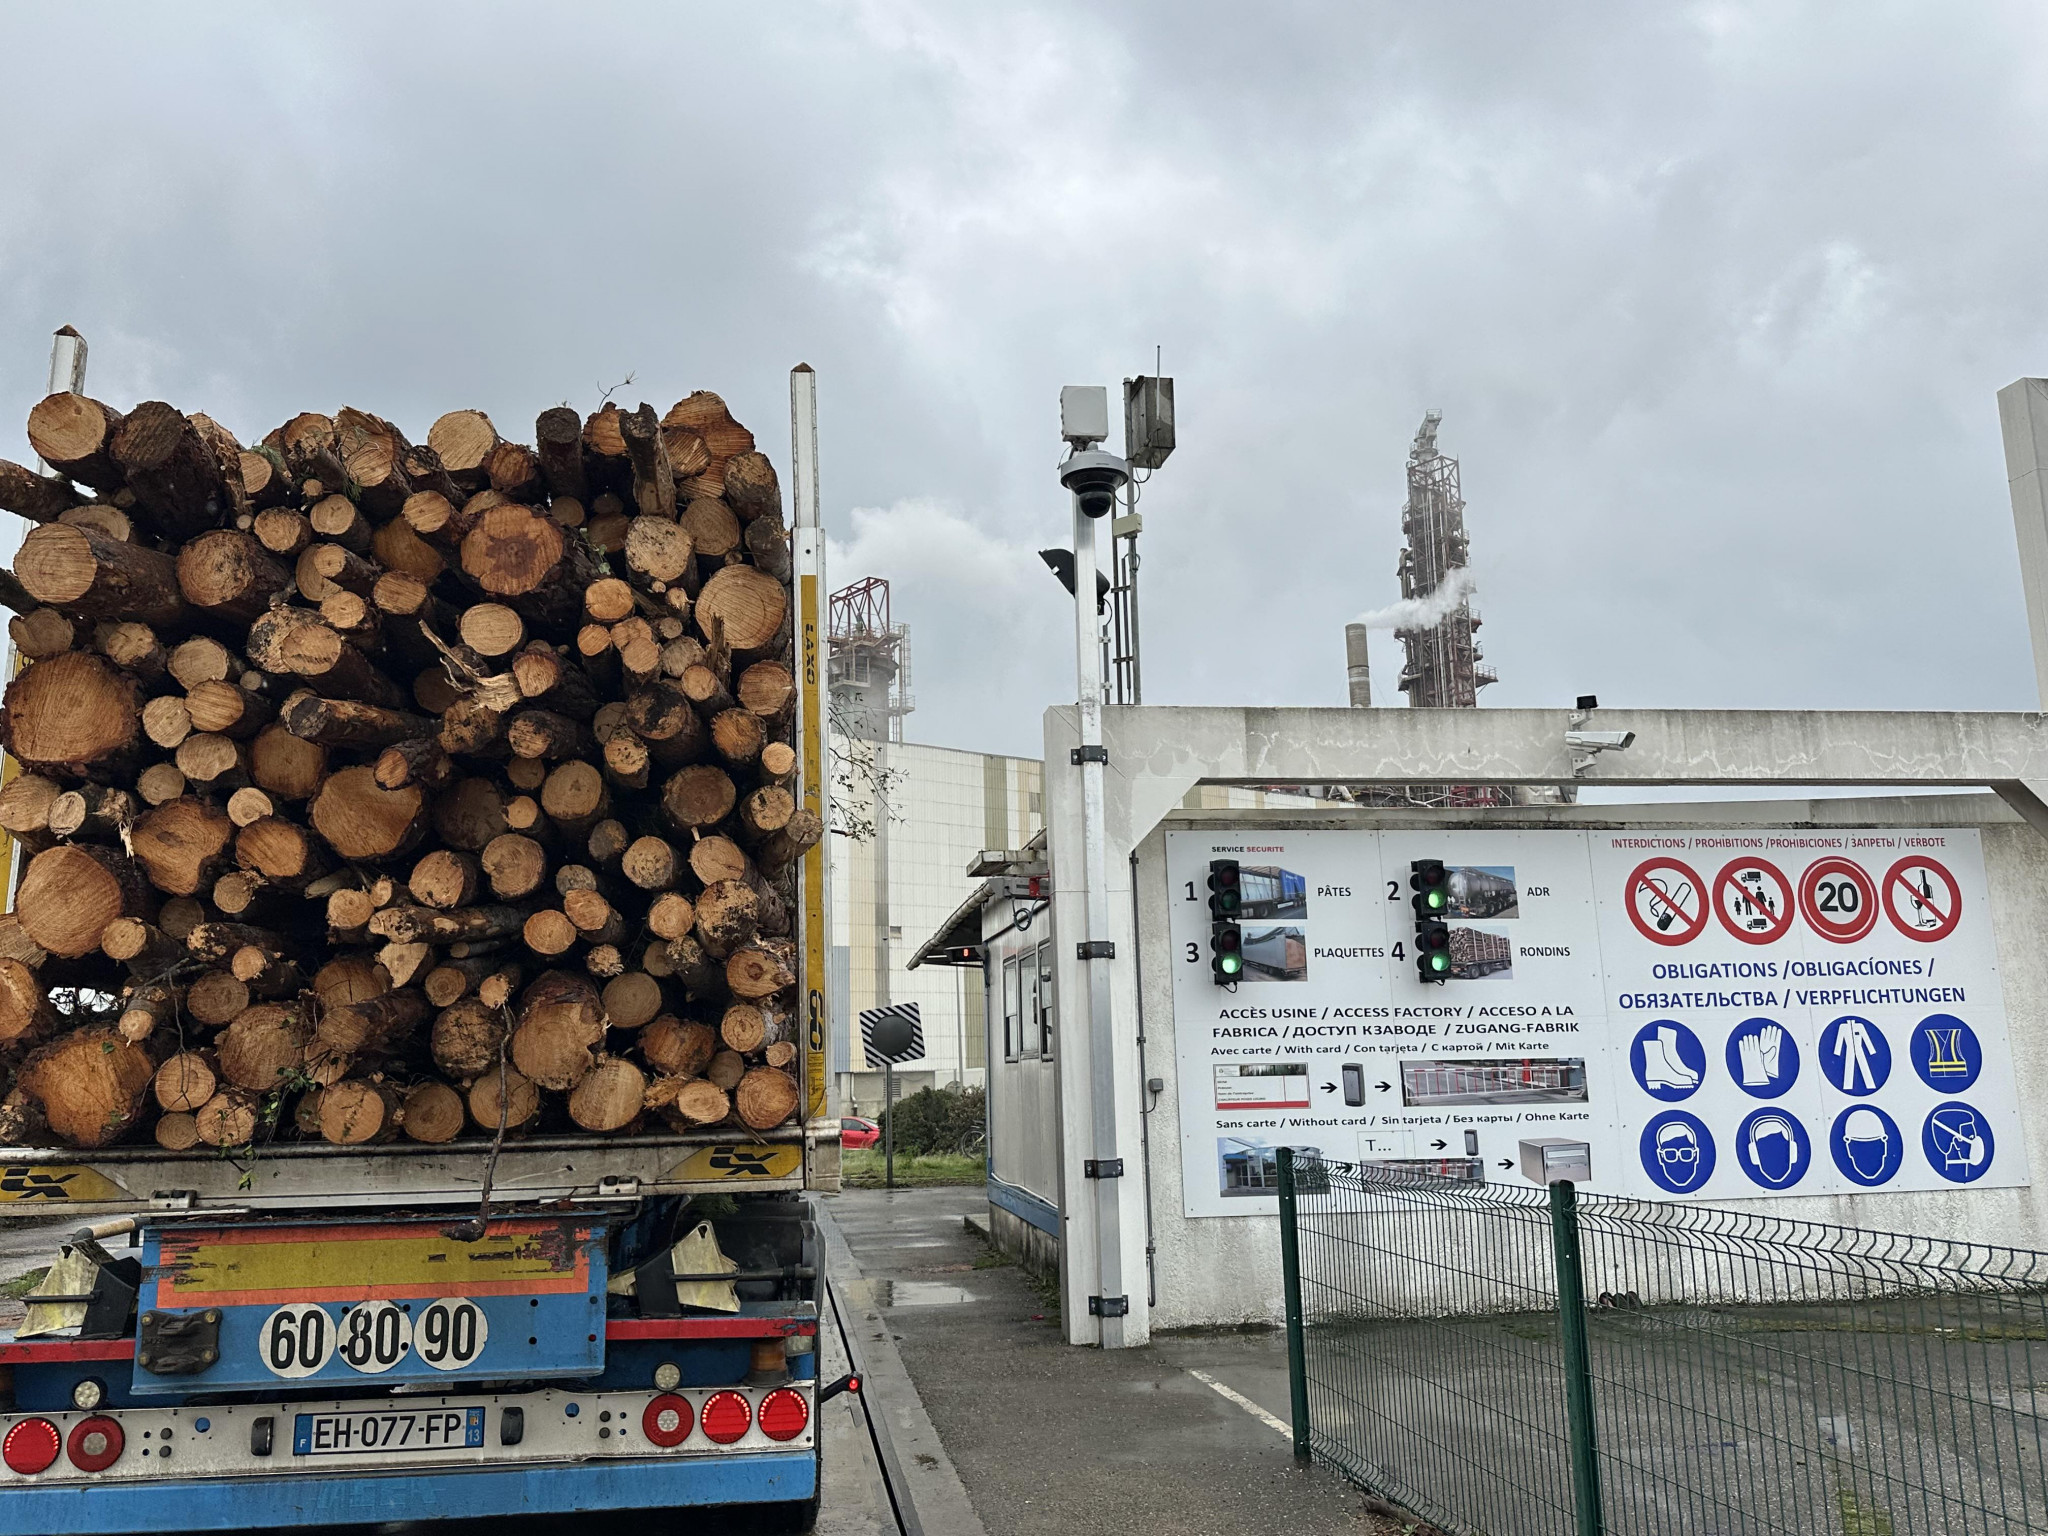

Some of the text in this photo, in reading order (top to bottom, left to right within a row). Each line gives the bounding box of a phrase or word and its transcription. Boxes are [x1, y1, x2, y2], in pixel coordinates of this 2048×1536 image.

[806, 623, 815, 685] LAXO
[1612, 839, 1685, 848] INTERDICTIONS
[1696, 838, 1763, 847] PROHIBITIONS
[1904, 838, 1945, 847] VERBOTE
[1185, 882, 1197, 901] 1
[1318, 885, 1351, 896] PÂTES
[1387, 881, 1400, 900] 2
[1528, 887, 1549, 896] ADR
[1818, 882, 1858, 912] 20
[1187, 943, 1199, 963] 3
[1315, 948, 1384, 958] PLAQUETTES
[1392, 942, 1405, 961] 4
[1520, 947, 1570, 956] RONDINS
[1653, 963, 1777, 979] OBLIGATIONS
[1796, 988, 1965, 1005] VERPFLICHTUNGEN
[1220, 1007, 1266, 1018] ACCÈS
[1272, 1009, 1316, 1018] USINE
[1334, 1008, 1389, 1017] ACCESS
[1395, 1008, 1462, 1017] FACTORY
[1479, 1007, 1536, 1016] ACCESO
[1542, 1007, 1551, 1015] A
[1556, 1007, 1573, 1015] LA
[1213, 1028, 1278, 1037] FABRICA
[1456, 1023, 1579, 1033] ZUGANG-FABRIK
[1317, 1045, 1341, 1053] card
[1379, 1045, 1417, 1053] tarjeta
[1289, 1118, 1338, 1126] Without
[1342, 1117, 1366, 1125] card
[1403, 1117, 1441, 1125] tarjeta
[1525, 1113, 1555, 1121] Ohne
[270, 1304, 477, 1370] 60 80 90
[299, 1413, 481, 1449] F EH-077-FP 13
